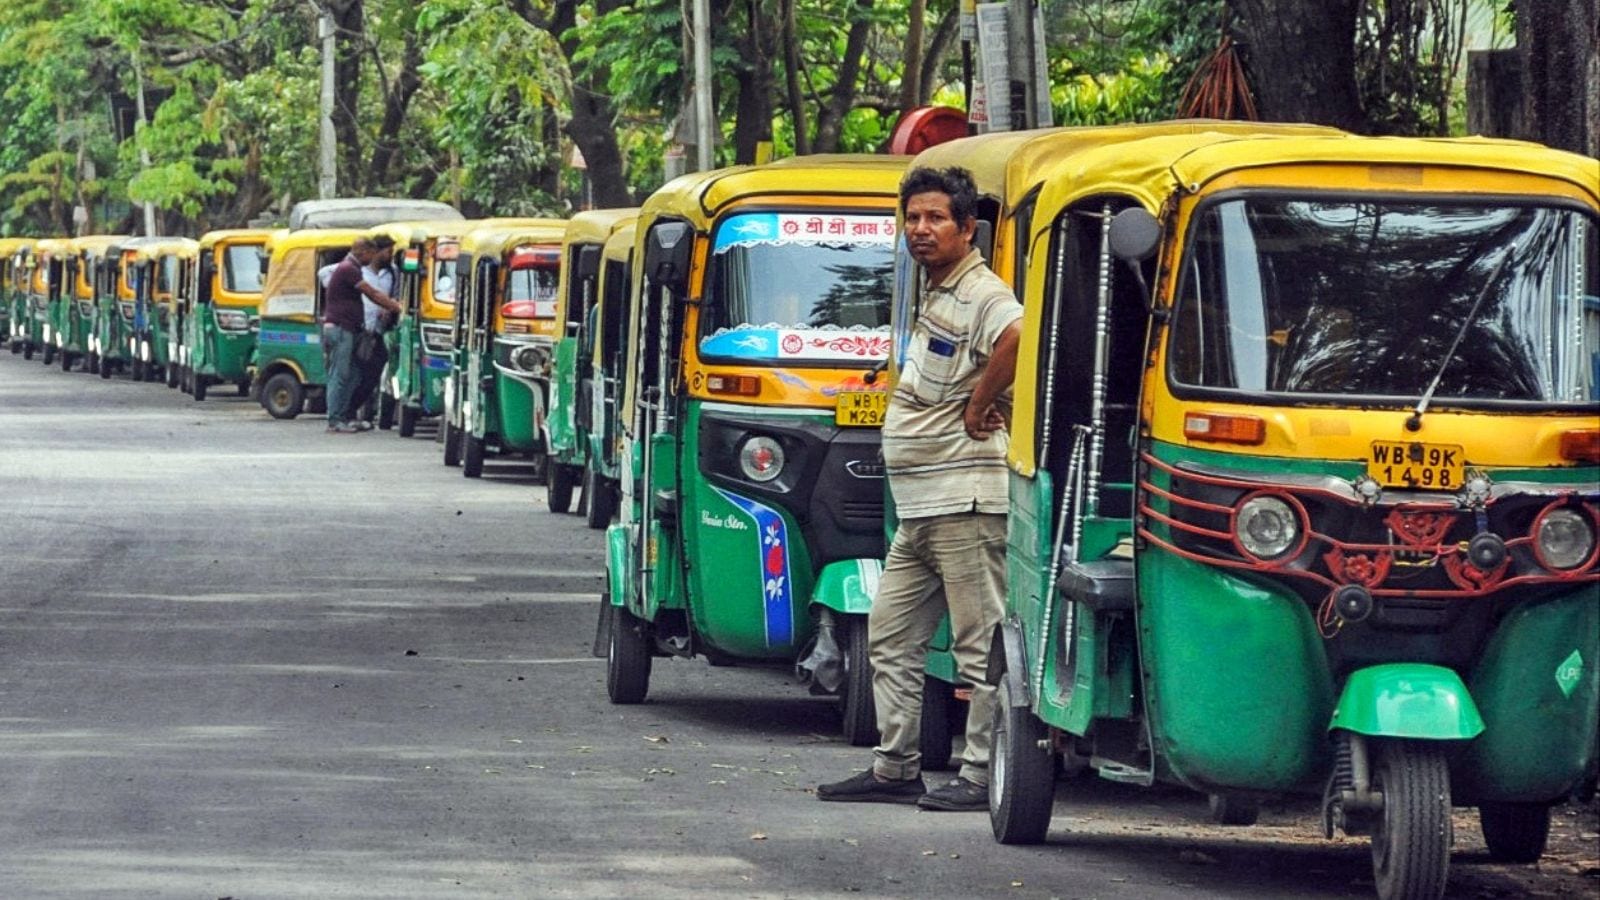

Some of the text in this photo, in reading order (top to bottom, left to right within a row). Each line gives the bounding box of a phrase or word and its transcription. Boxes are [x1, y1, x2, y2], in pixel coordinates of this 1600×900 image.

[806, 217, 897, 236] শ্রী শ্রী রাম ঠ
[1383, 466, 1450, 487] 1498
